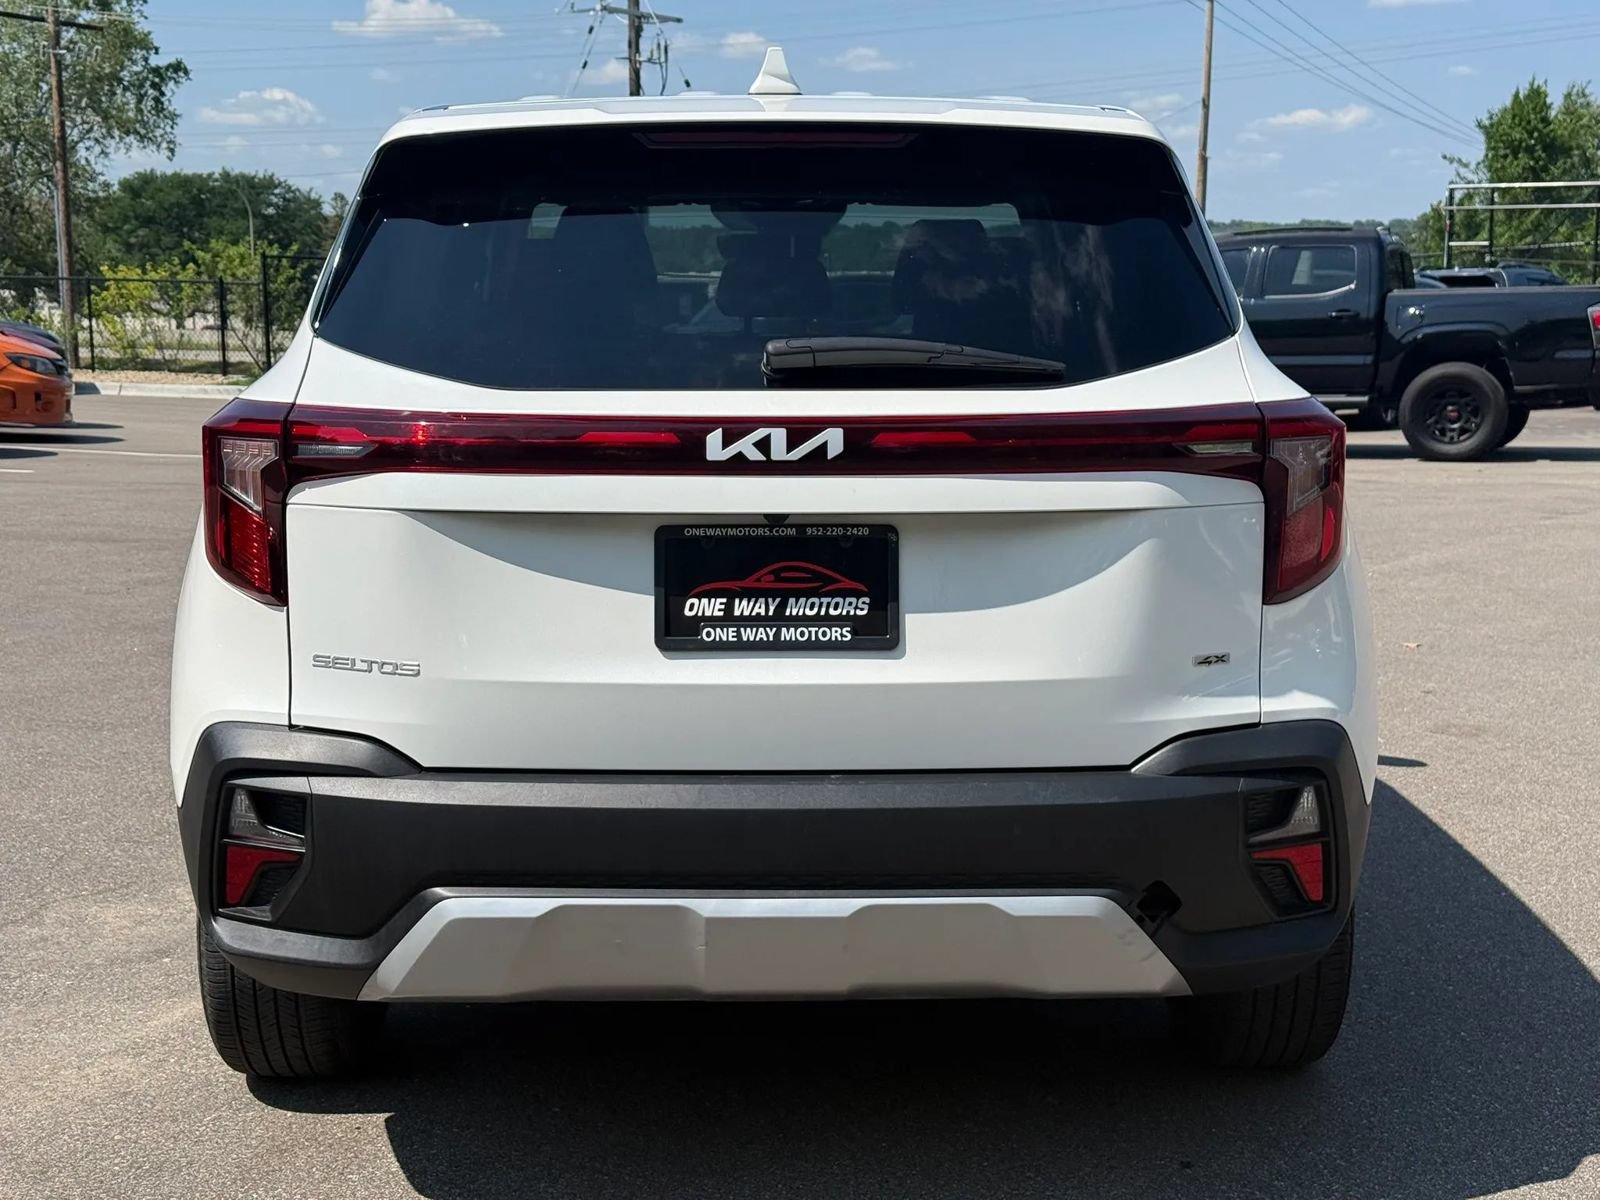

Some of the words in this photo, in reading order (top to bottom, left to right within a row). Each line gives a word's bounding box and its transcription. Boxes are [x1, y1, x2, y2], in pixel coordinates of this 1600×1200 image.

[706, 427, 844, 461] KIA
[684, 527, 796, 536] ONEWAYMOTORS.COM
[806, 527, 869, 536] 952-220-2420
[684, 598, 726, 616] ONE
[734, 598, 780, 616] WAY
[785, 597, 870, 616] MOTORS
[702, 627, 737, 641] ONE
[740, 627, 776, 641] WAY
[781, 627, 851, 641] MOTORS
[312, 653, 421, 678] SELTOS
